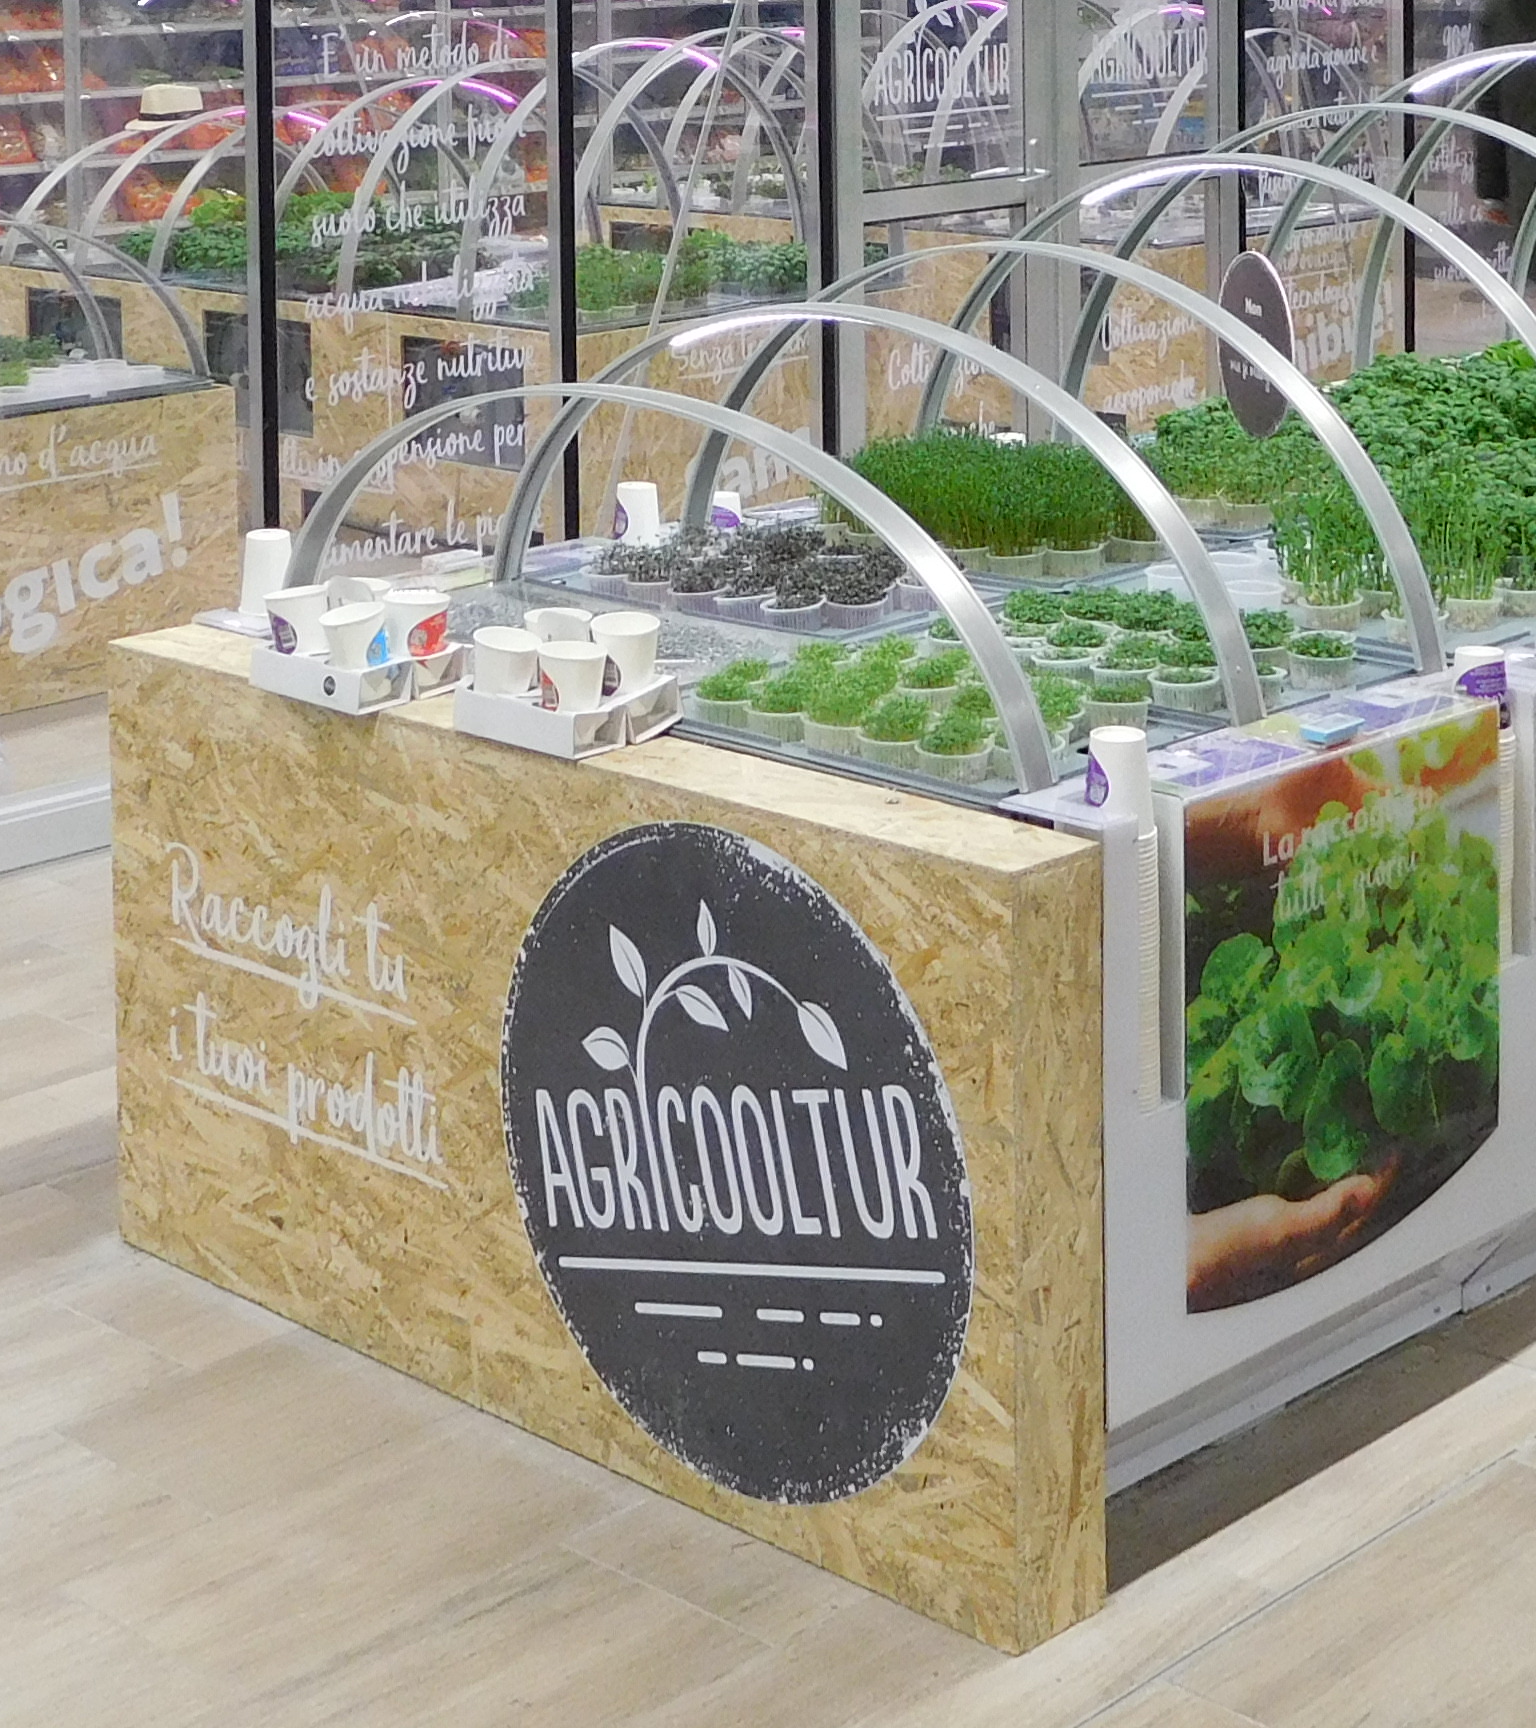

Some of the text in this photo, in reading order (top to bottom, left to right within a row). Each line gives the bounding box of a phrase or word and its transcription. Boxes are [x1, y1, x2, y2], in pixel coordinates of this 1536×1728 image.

[353, 45, 388, 73] un
[395, 21, 480, 72] metodo
[487, 18, 510, 64] di
[385, 179, 425, 233] che
[304, 290, 385, 334] acqua
[304, 330, 537, 410] e sostanze nutritive
[38, 422, 159, 479] d'acqua
[493, 421, 527, 467] per
[446, 496, 469, 548] le
[1262, 830, 1295, 867] La
[165, 840, 409, 1010] Raccogli tu
[167, 990, 447, 1167] i tuoi prodotti
[534, 1084, 939, 1242] AGRICOOLTUR
